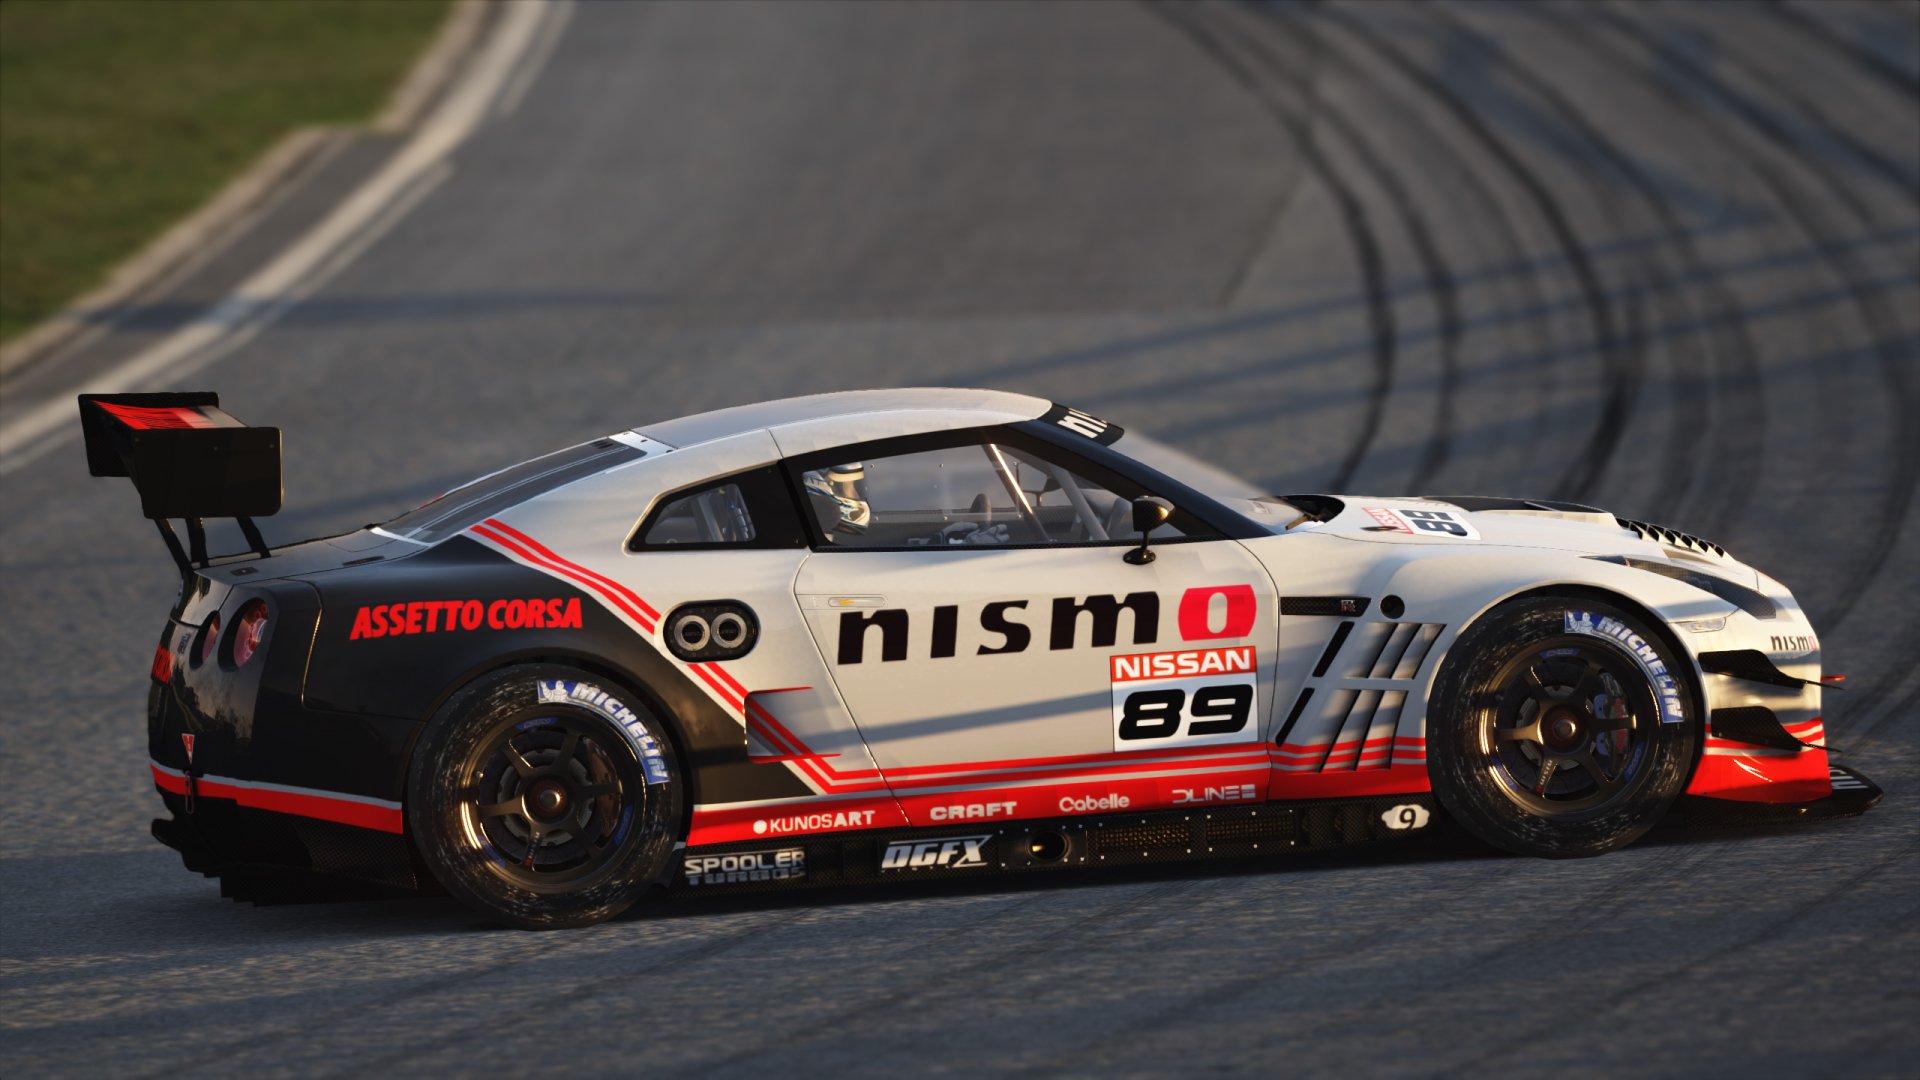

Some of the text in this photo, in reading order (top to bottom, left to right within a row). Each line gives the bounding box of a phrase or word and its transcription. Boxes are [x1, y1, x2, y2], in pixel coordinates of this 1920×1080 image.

[349, 597, 583, 641] ASSETTO CORSA
[837, 584, 1258, 665] nismo
[1770, 635, 1818, 651] nismo
[1115, 649, 1251, 680] NISSAN
[1597, 616, 1684, 718] MICHELIN
[1118, 683, 1254, 742] 89
[570, 682, 669, 778] MICHELIN
[930, 801, 1017, 821] CRAFT
[1059, 793, 1130, 813] Cabelle
[1399, 807, 1416, 830] 9
[684, 851, 805, 875] SPOOLER
